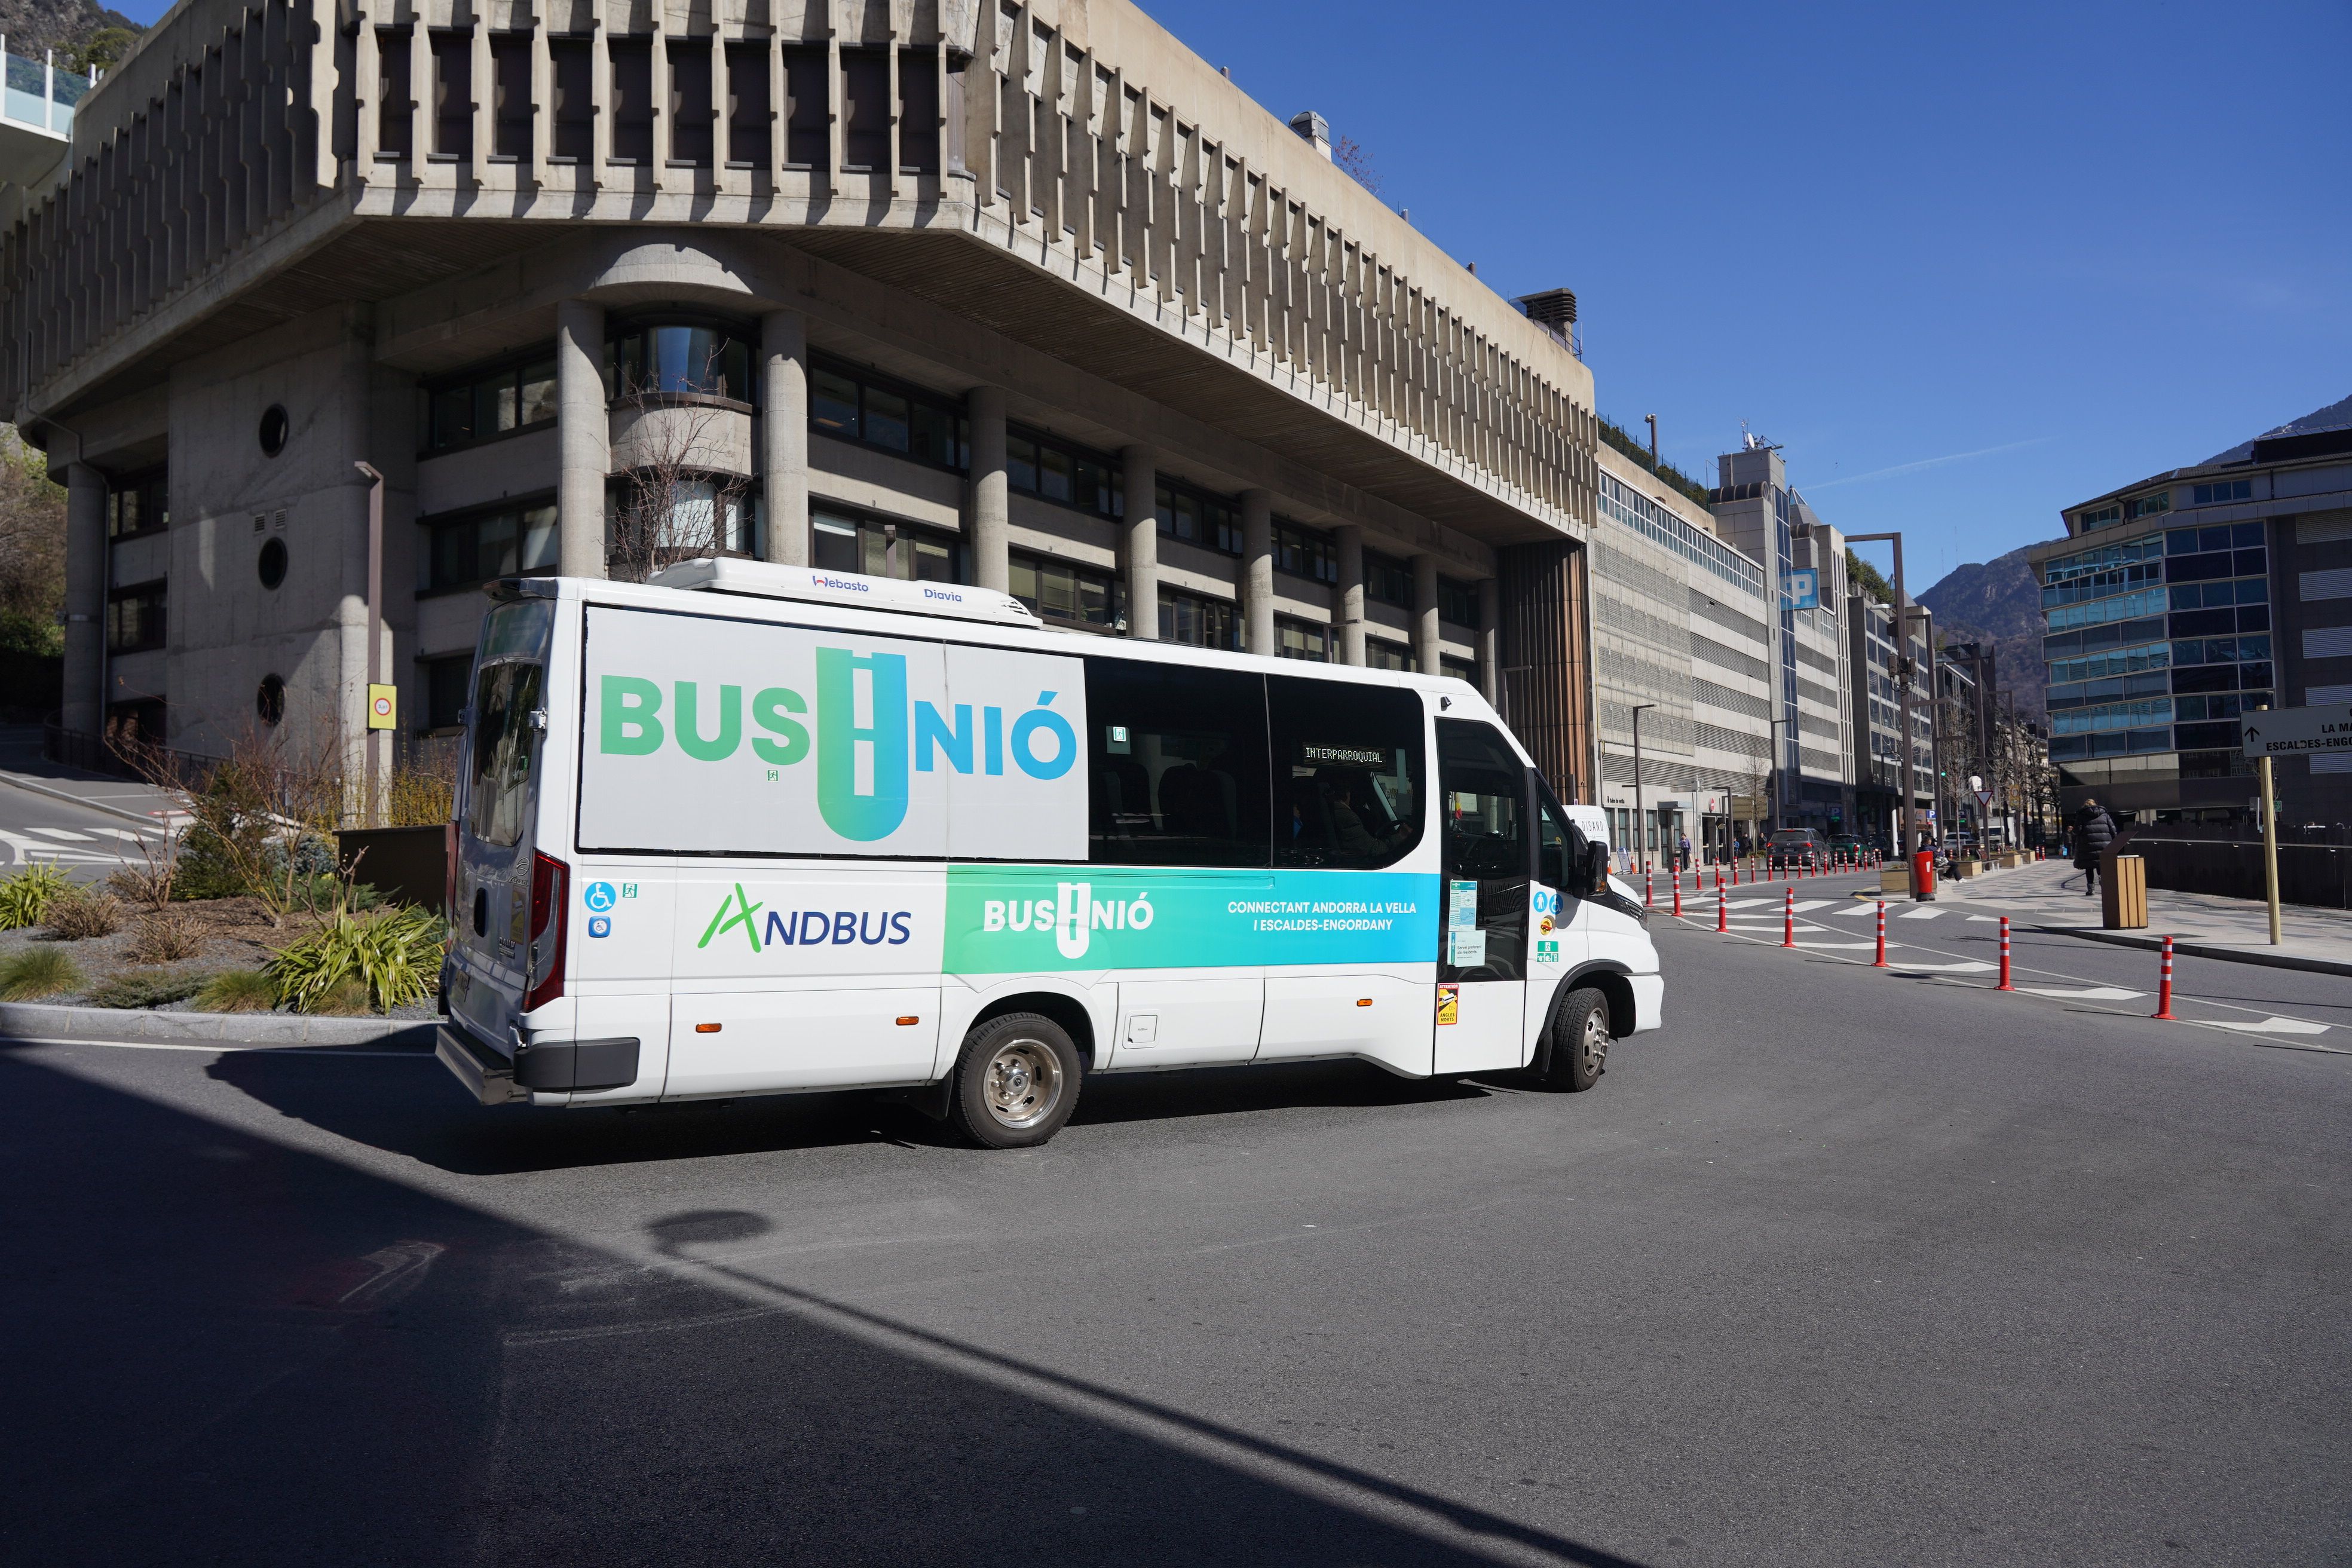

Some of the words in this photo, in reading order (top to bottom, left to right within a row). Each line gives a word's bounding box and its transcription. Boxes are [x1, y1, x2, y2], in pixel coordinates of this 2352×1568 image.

[812, 575, 868, 592] Webasto
[924, 589, 962, 602] Diavia
[2322, 724, 2335, 733] LA
[1306, 747, 1383, 762] INTERPARROQUIAL
[1228, 901, 1310, 913] CONNECTANT
[1312, 902, 1367, 913] ANDORRA
[1370, 902, 1383, 913] LA
[1386, 902, 1417, 913] VELLA
[697, 883, 911, 953] ANDBUS
[1254, 920, 1257, 930] I
[1260, 920, 1393, 930] ESCALDES-ENGORDANY
